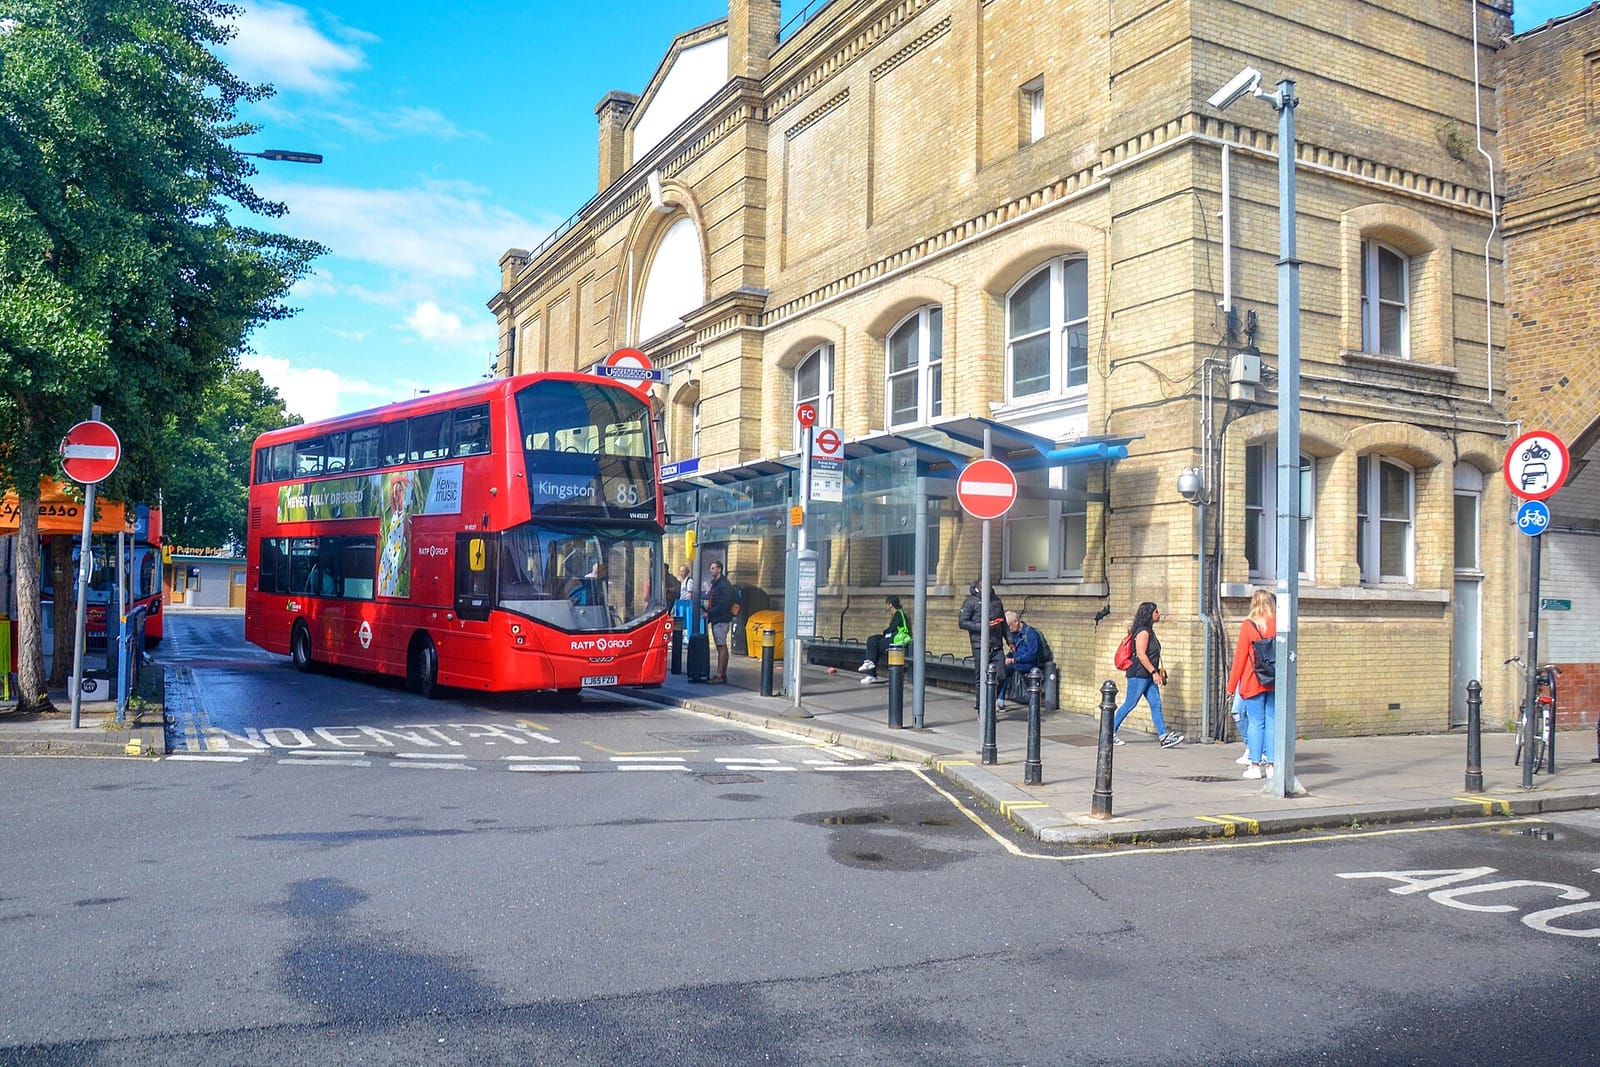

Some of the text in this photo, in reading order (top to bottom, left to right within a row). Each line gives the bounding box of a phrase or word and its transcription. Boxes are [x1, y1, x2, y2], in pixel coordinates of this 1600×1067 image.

[801, 409, 814, 420] FC
[308, 492, 330, 505] FULLY
[330, 490, 364, 505] DRESSED
[435, 489, 458, 502] music
[539, 480, 638, 504] Kingston 85
[176, 545, 204, 556] Putney
[571, 640, 633, 650] RATP GROUP
[203, 727, 316, 749] NO
